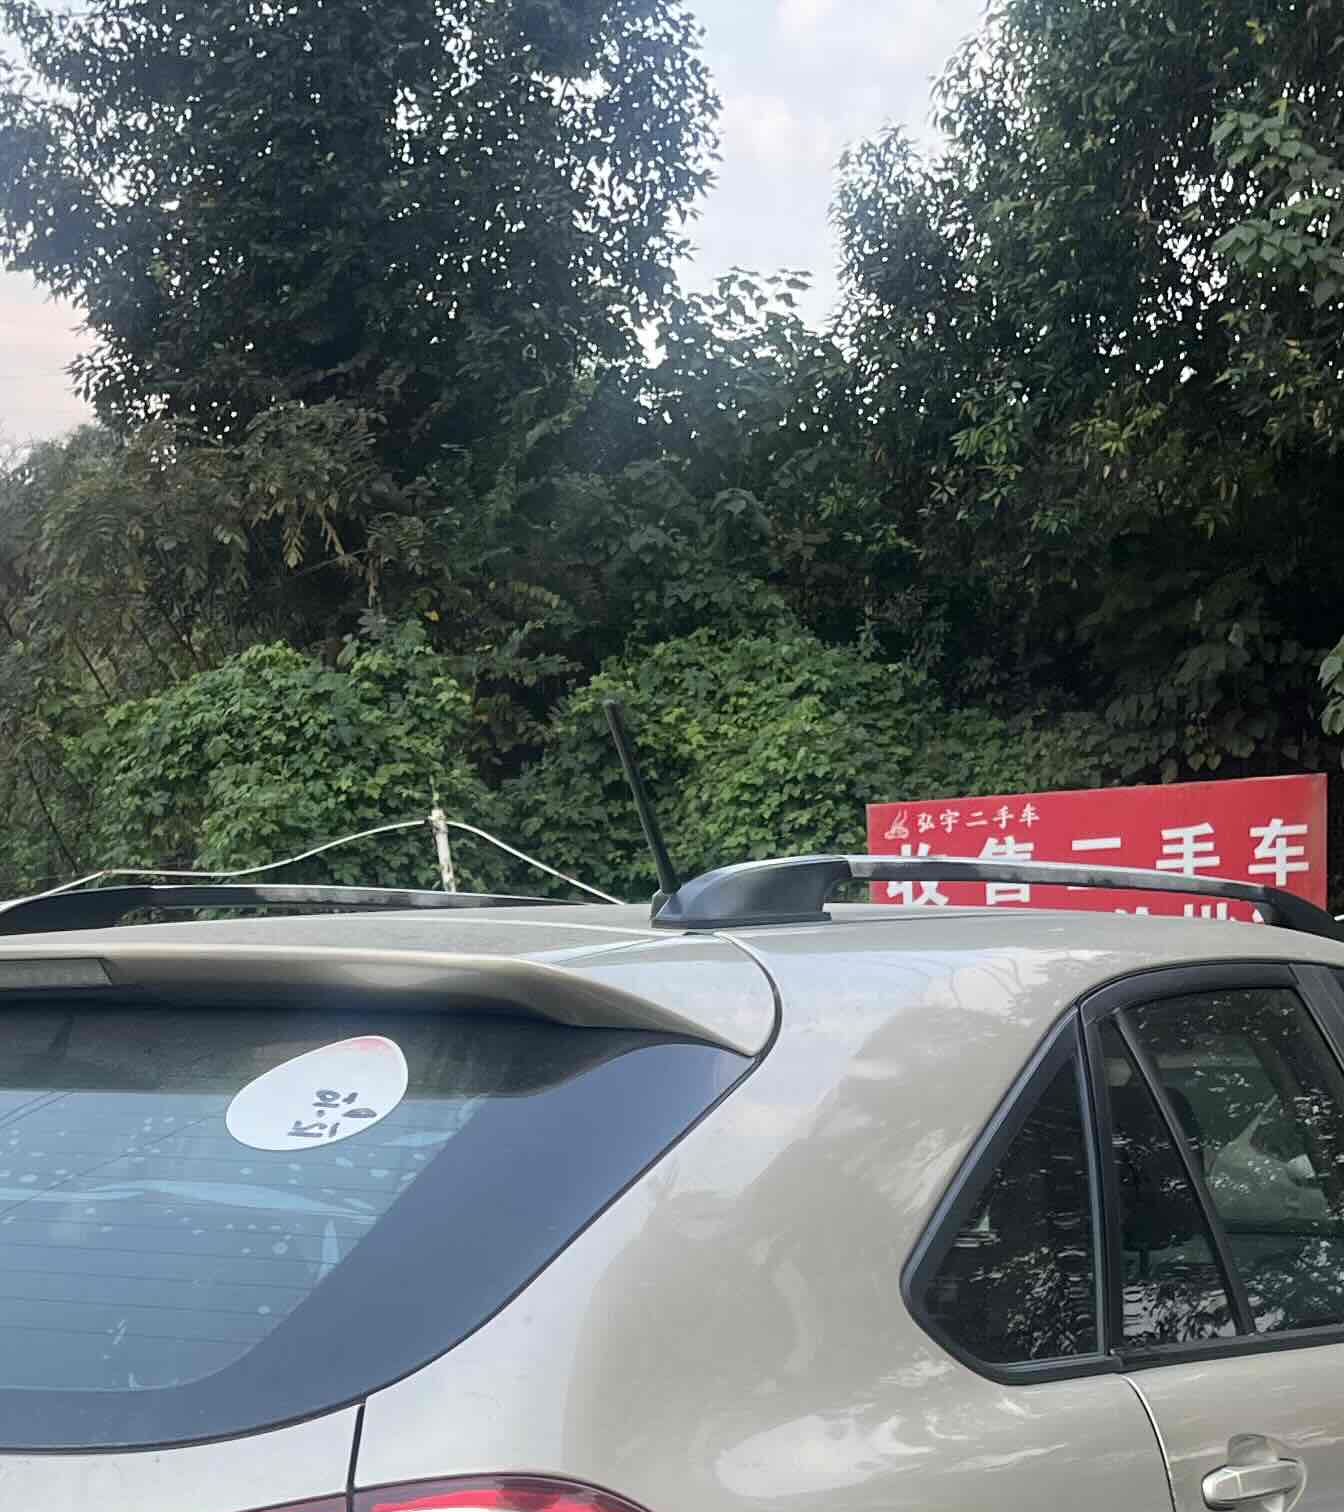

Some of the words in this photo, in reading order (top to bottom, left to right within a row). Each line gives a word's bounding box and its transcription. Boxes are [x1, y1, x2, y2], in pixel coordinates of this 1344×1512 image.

[916, 802, 1041, 834] 弘宇二手车
